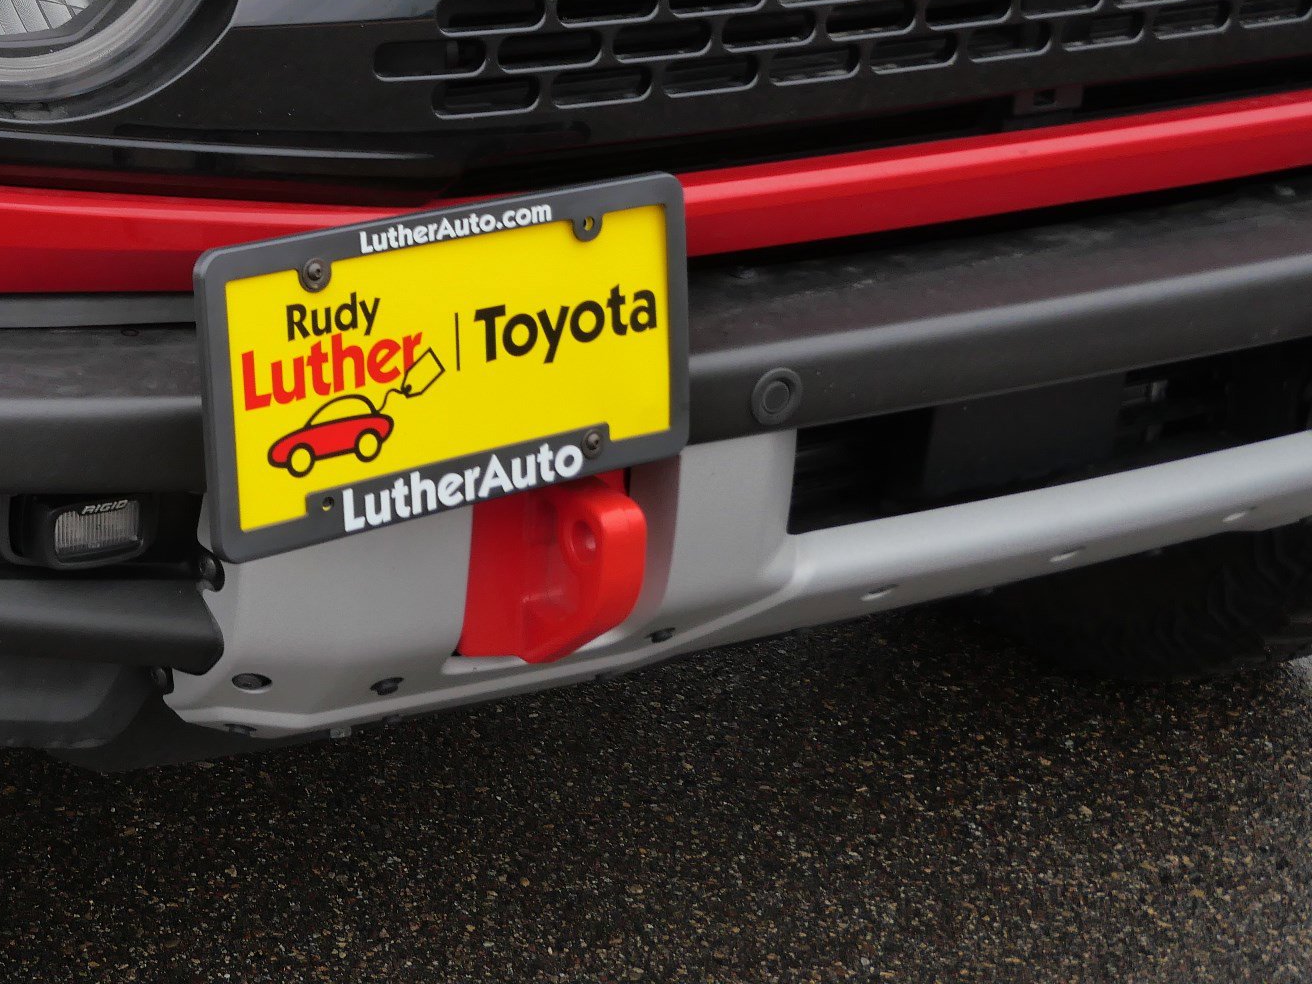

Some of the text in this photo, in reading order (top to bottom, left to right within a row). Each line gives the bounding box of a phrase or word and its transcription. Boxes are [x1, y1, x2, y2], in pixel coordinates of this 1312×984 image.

[358, 203, 554, 255] LutherAuto.com
[284, 291, 381, 342] Rudy
[473, 283, 659, 365] Toyota
[241, 331, 425, 412] Luther
[80, 498, 130, 515] RIGID
[341, 442, 585, 533] LutherAuto
